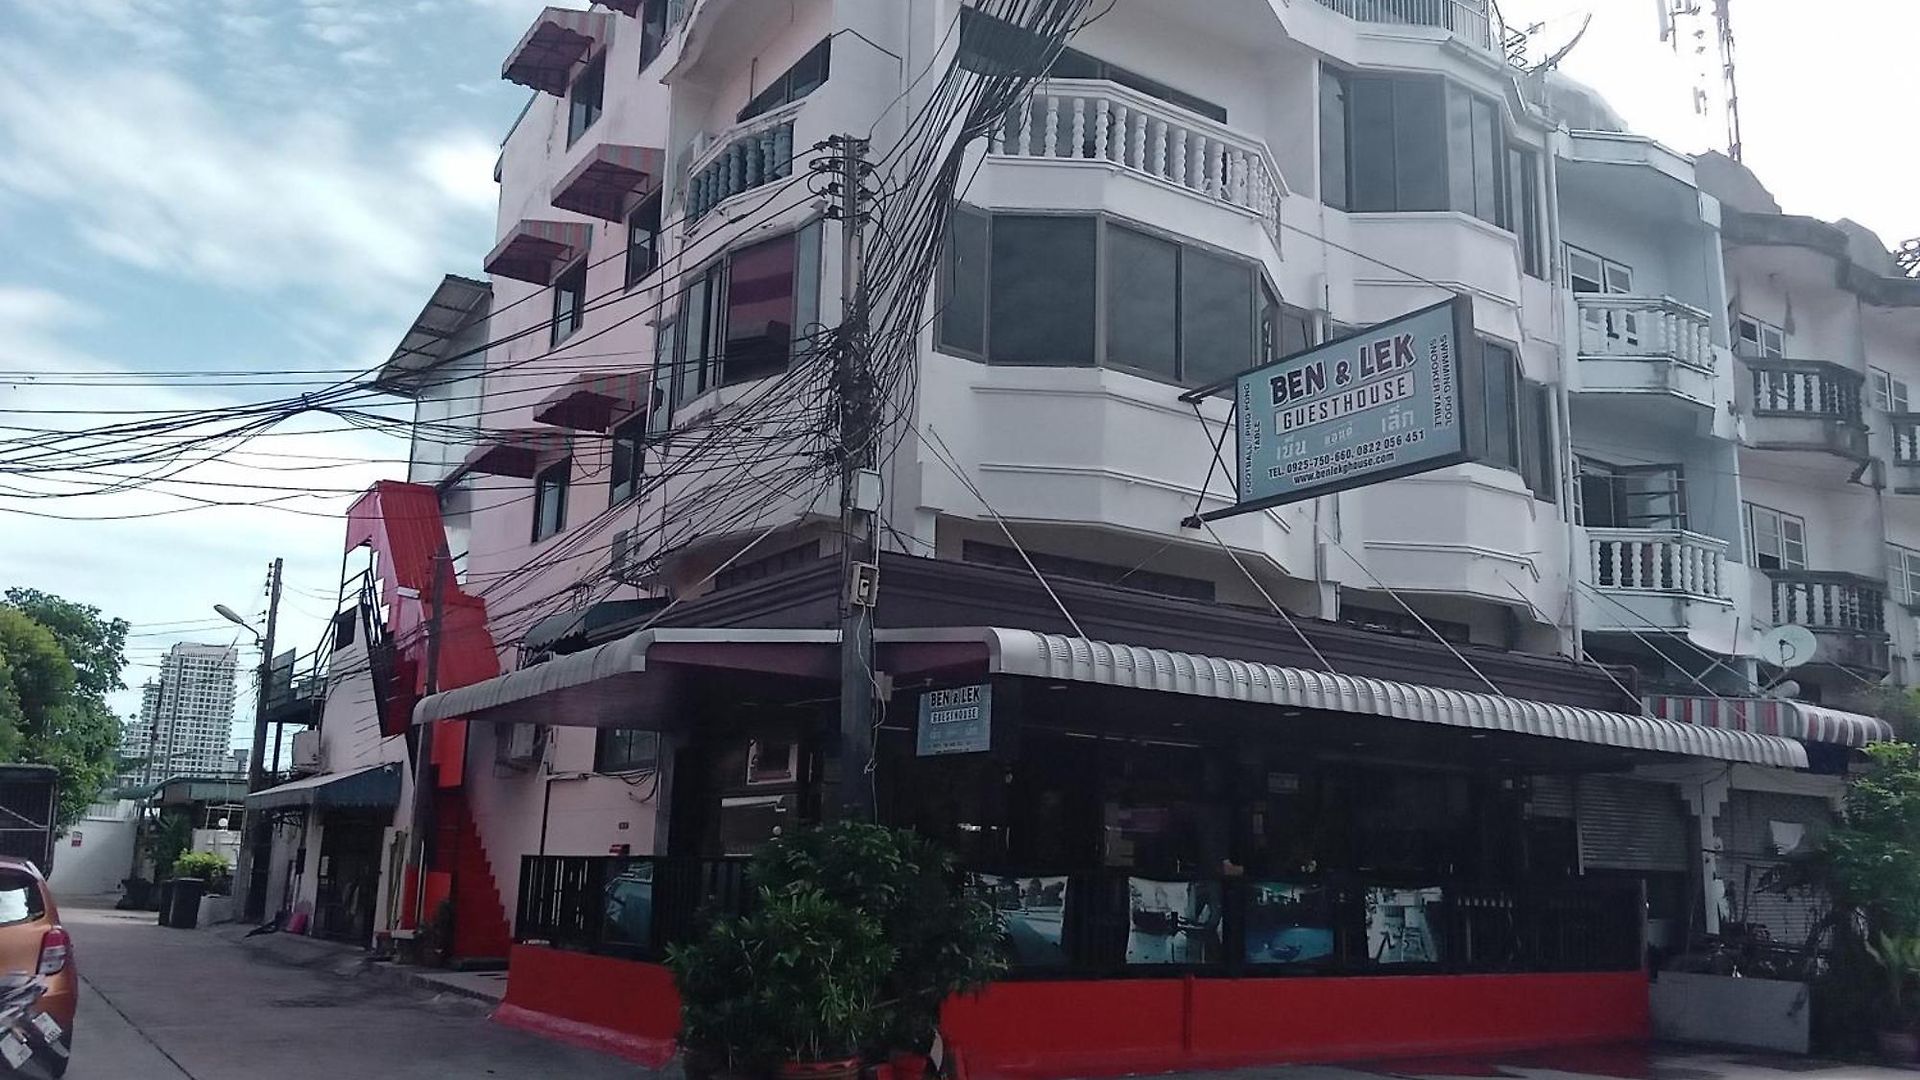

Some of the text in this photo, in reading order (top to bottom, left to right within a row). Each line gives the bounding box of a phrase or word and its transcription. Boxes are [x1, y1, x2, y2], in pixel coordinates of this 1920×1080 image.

[1270, 333, 1416, 405] BEN & LEK
[1430, 339, 1440, 392] SNOOKER
[1440, 334, 1452, 426] SWIMMING POOL
[1284, 377, 1406, 430] GUESTHOUSE
[1268, 467, 1285, 478] TEL.
[1357, 441, 1381, 456] 0822
[1384, 435, 1402, 449] 056
[1405, 429, 1424, 443] 451
[930, 690, 950, 707] BEN
[960, 686, 980, 703] LEK
